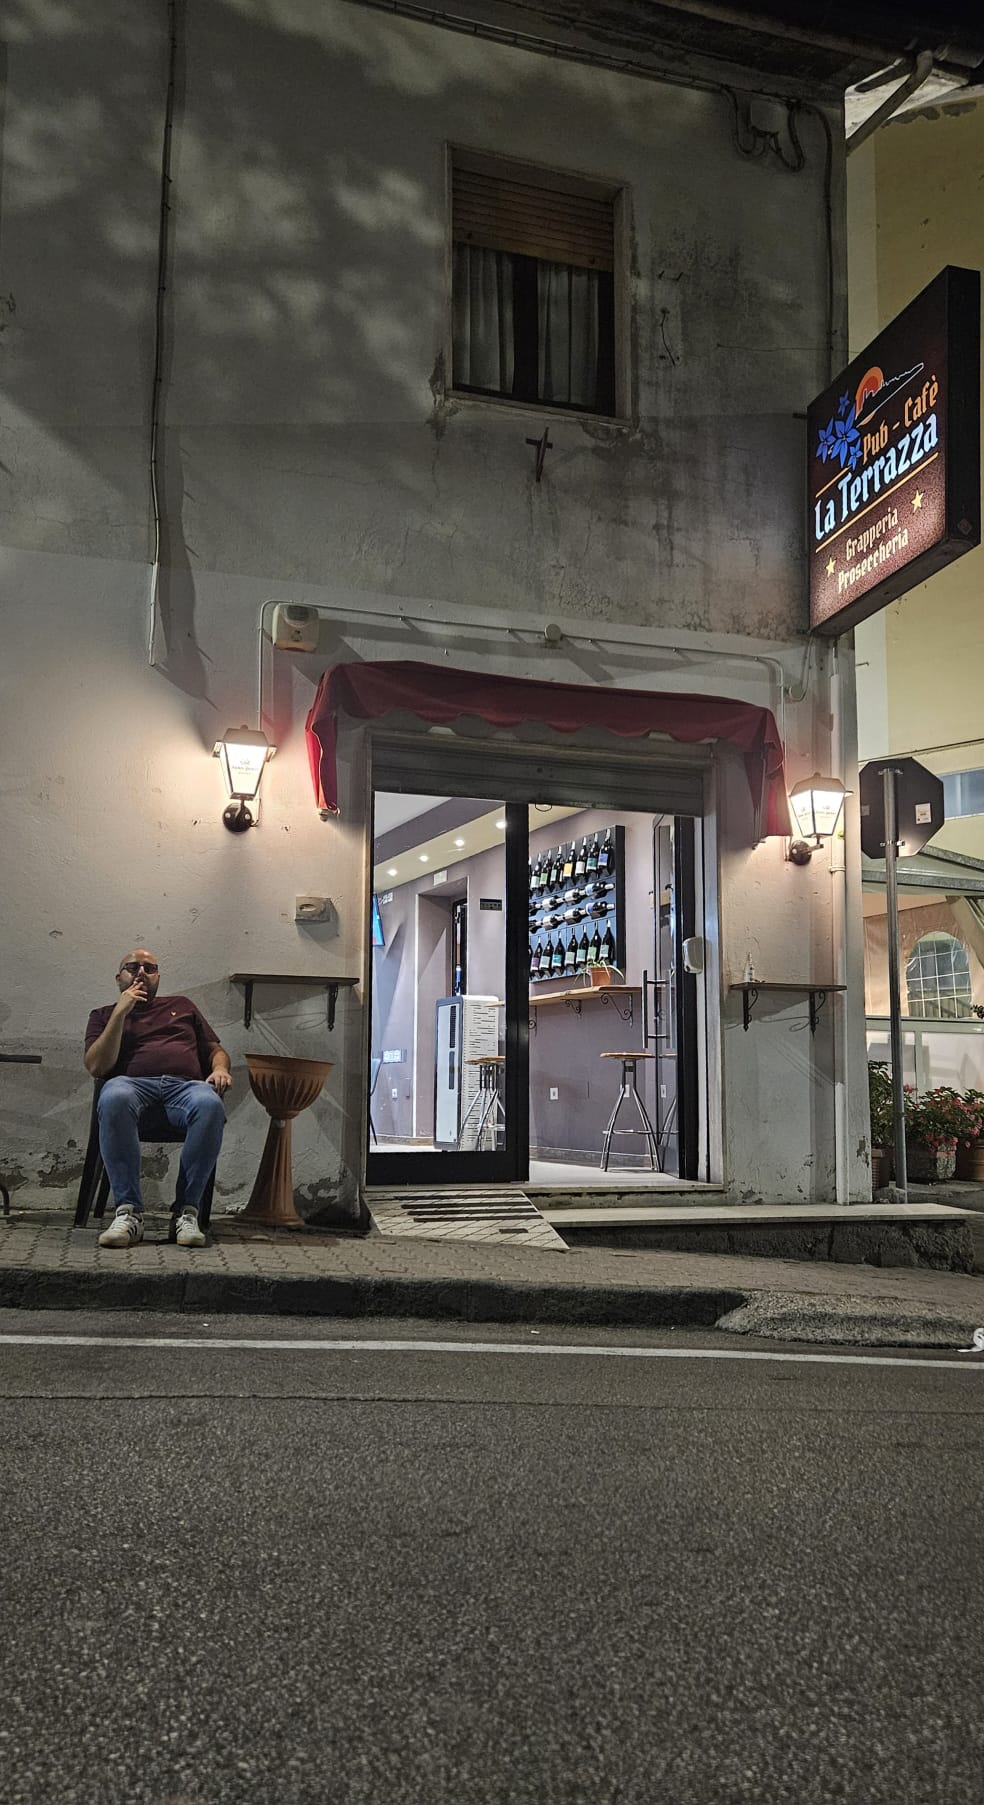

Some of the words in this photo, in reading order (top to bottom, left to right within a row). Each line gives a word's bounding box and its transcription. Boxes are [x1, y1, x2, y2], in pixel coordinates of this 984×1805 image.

[862, 420, 888, 465] Pub
[814, 499, 836, 540] La
[838, 413, 939, 522] Terrazza
[838, 527, 909, 594] Proseccheria
[846, 506, 898, 561] Grapperia
